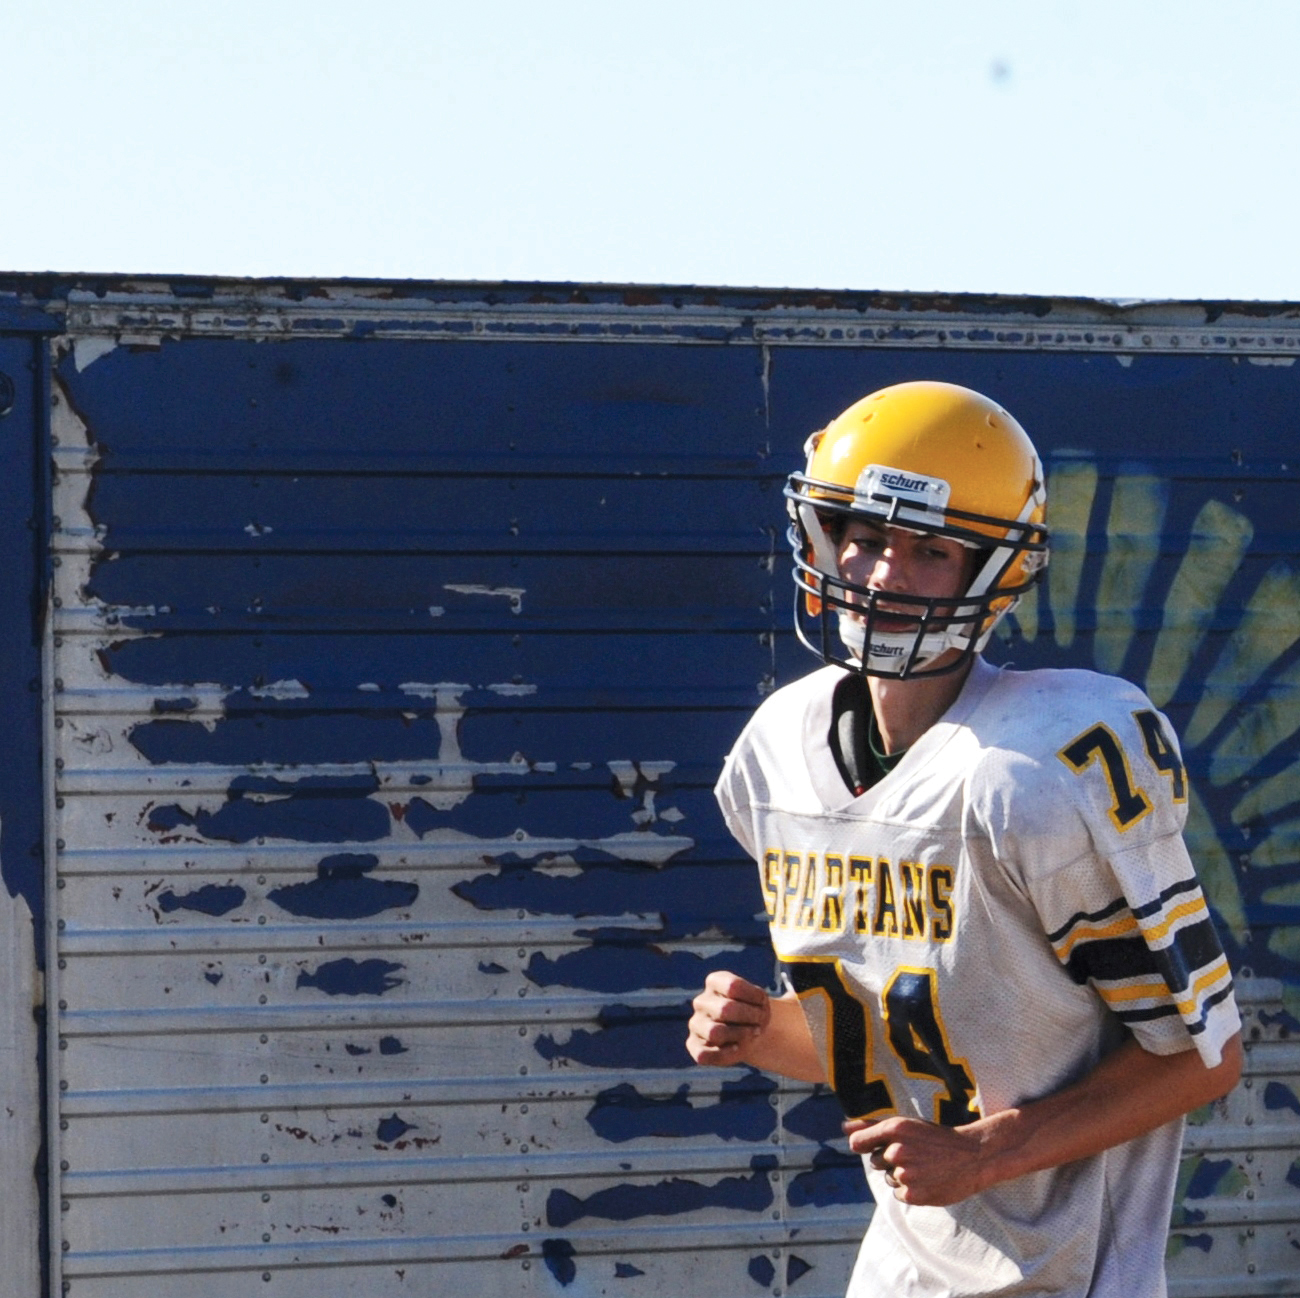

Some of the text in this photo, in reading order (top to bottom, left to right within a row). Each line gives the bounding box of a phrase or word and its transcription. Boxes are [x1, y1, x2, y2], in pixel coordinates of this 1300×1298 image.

[880, 473, 929, 492] schutt
[867, 643, 905, 656] chutt
[1056, 708, 1189, 834] 74
[763, 849, 955, 943] SPARTANS
[777, 954, 983, 1128] 74
